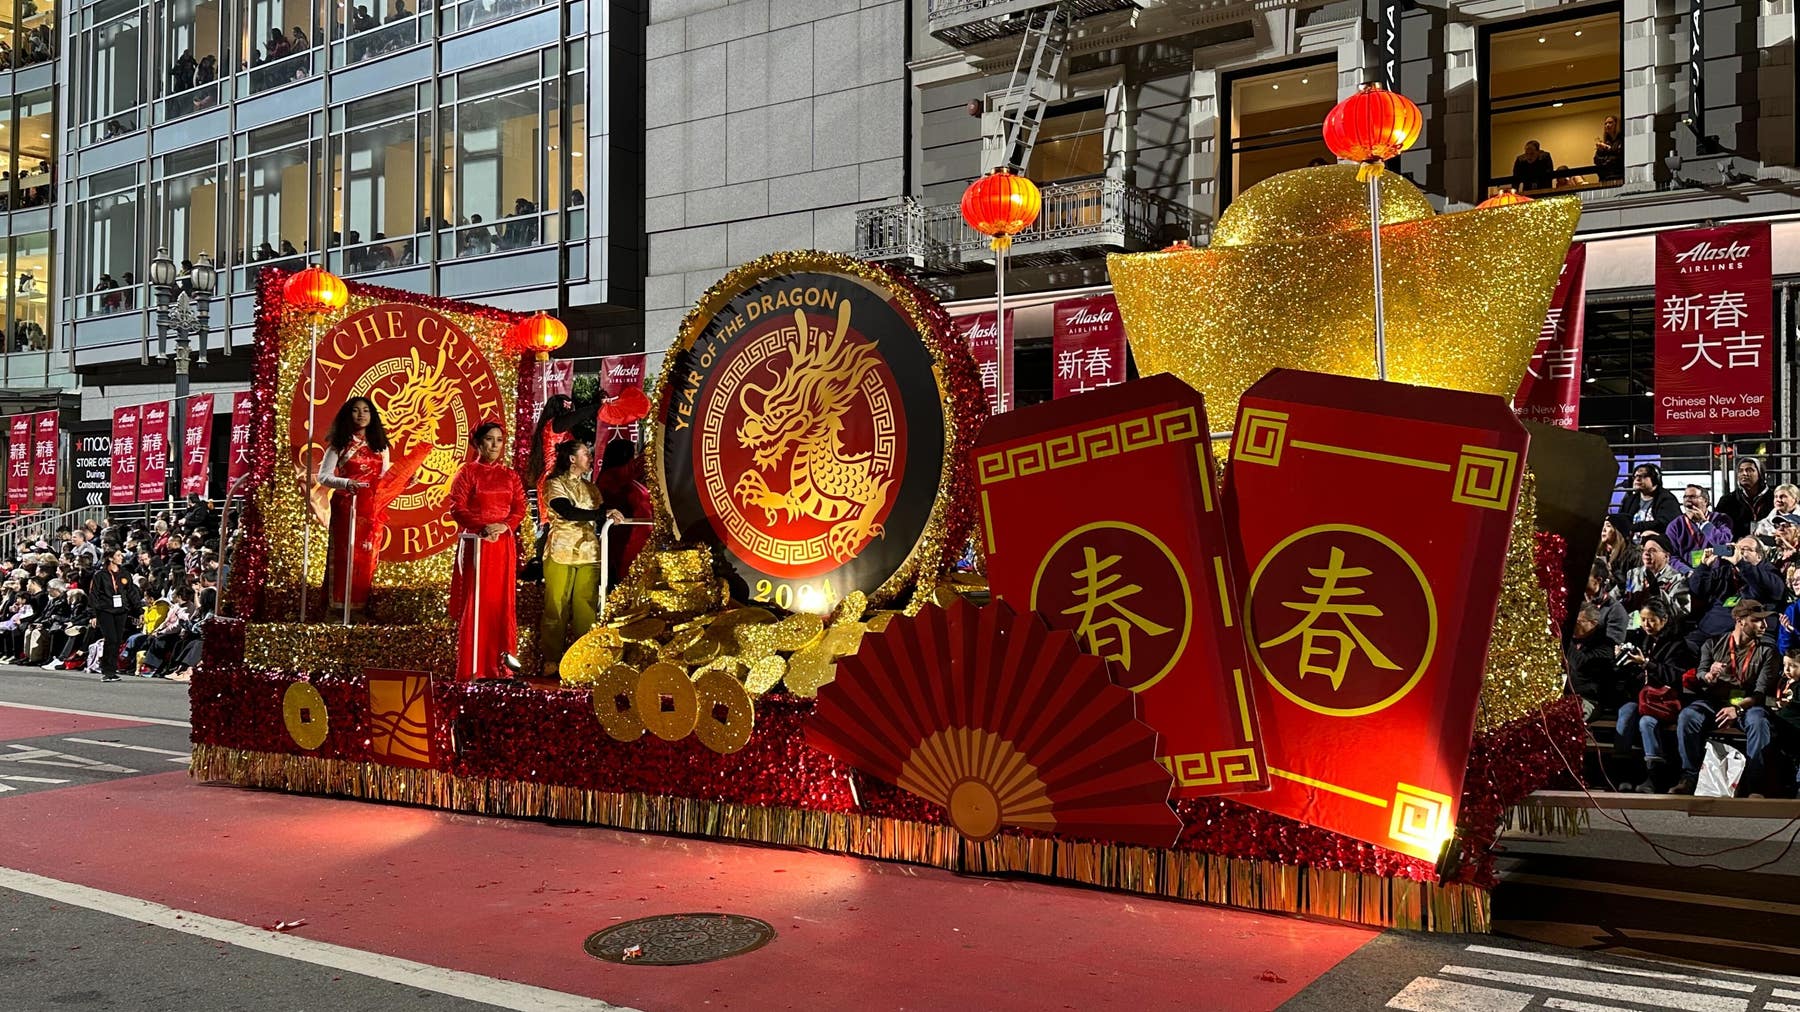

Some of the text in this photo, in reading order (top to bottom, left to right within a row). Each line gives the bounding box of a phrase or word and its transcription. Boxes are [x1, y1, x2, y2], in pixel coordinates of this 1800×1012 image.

[1386, 5, 1395, 93] ANA
[1692, 0, 1700, 117] CUYA
[1675, 240, 1751, 264] Alaska
[1680, 262, 1743, 273] AIRLINES
[1066, 307, 1113, 326] Alaska
[1662, 290, 1748, 332] 新春
[1069, 325, 1109, 334] AIRLINES
[675, 287, 838, 431] YEAR OF THE DRAGON
[1681, 331, 1764, 371] 大吉
[303, 310, 501, 421] CACHE CREEK
[608, 364, 640, 377] Alaska
[1058, 347, 1112, 380] 新春
[979, 360, 998, 389] 春
[988, 393, 1010, 416] 吉
[1662, 393, 1765, 407] Chinese New Year
[1666, 407, 1760, 419] Festival & Parade
[36, 440, 54, 458] 新春
[84, 436, 112, 456] macy
[113, 436, 134, 455] 新春
[142, 432, 162, 452] 新春
[76, 457, 112, 467] STORE OPE
[145, 452, 165, 471] 大吉
[235, 445, 249, 463] 大
[12, 461, 29, 477] 大吉
[39, 458, 56, 475] 大吉
[116, 455, 136, 474] 大吉
[86, 470, 105, 479] During
[401, 511, 458, 554] RES
[1060, 546, 1175, 672] 春
[1259, 546, 1404, 692] 春
